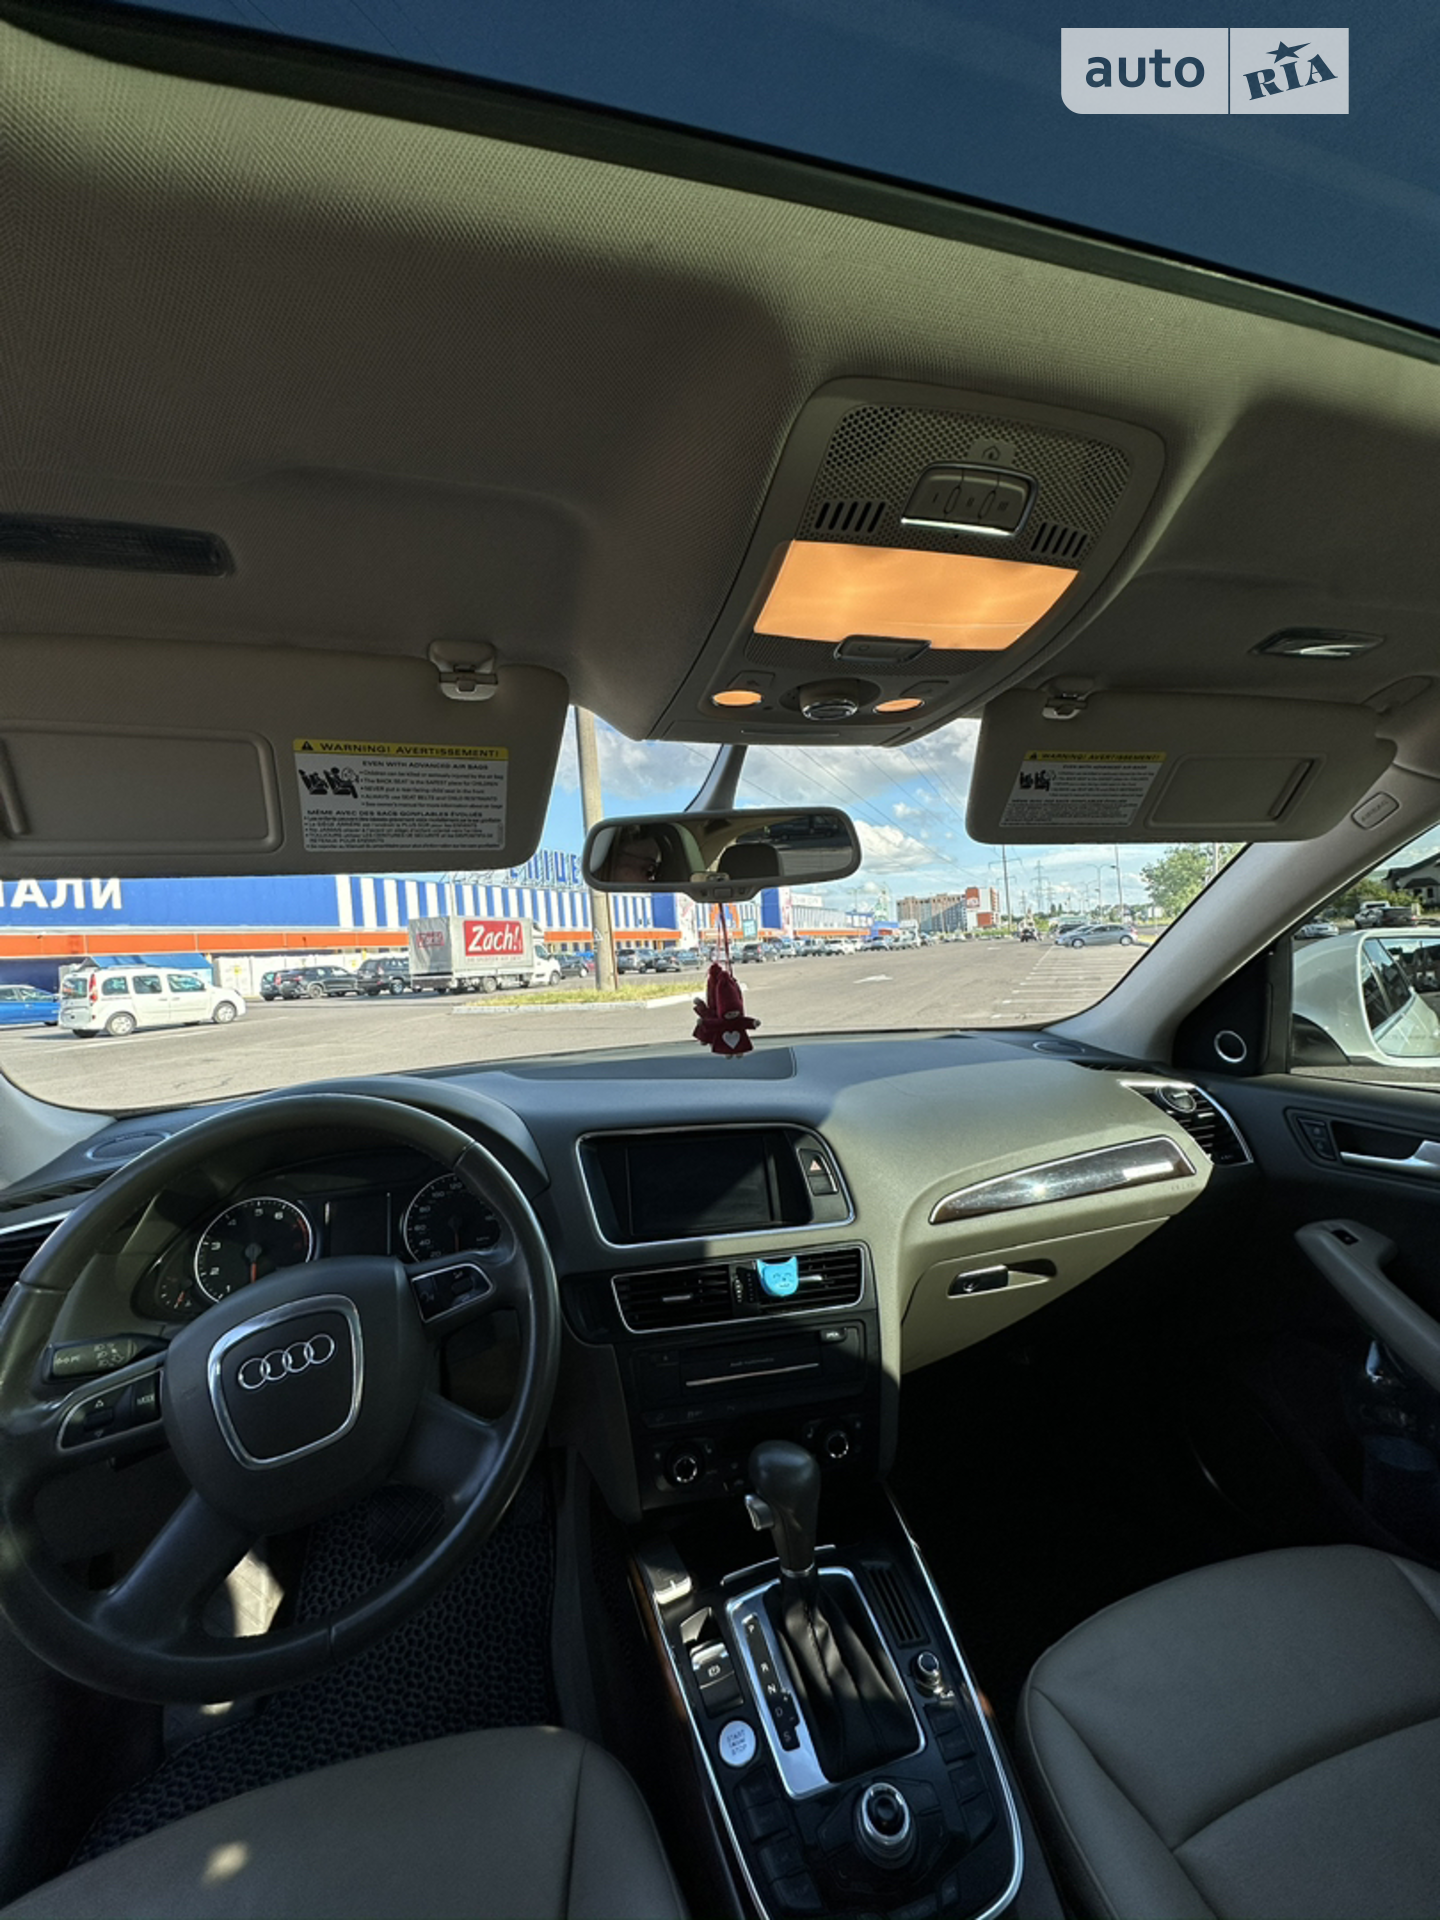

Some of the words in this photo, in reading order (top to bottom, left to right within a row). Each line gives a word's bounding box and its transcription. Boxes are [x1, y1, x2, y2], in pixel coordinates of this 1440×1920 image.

[320, 742, 391, 753] WARNING!
[395, 746, 499, 757] AVERTISSEMENT!
[0, 878, 122, 910] АЛИ
[467, 923, 520, 952] Zach!
[767, 1683, 776, 1695] N
[775, 1706, 783, 1717] D
[783, 1730, 791, 1742] S
